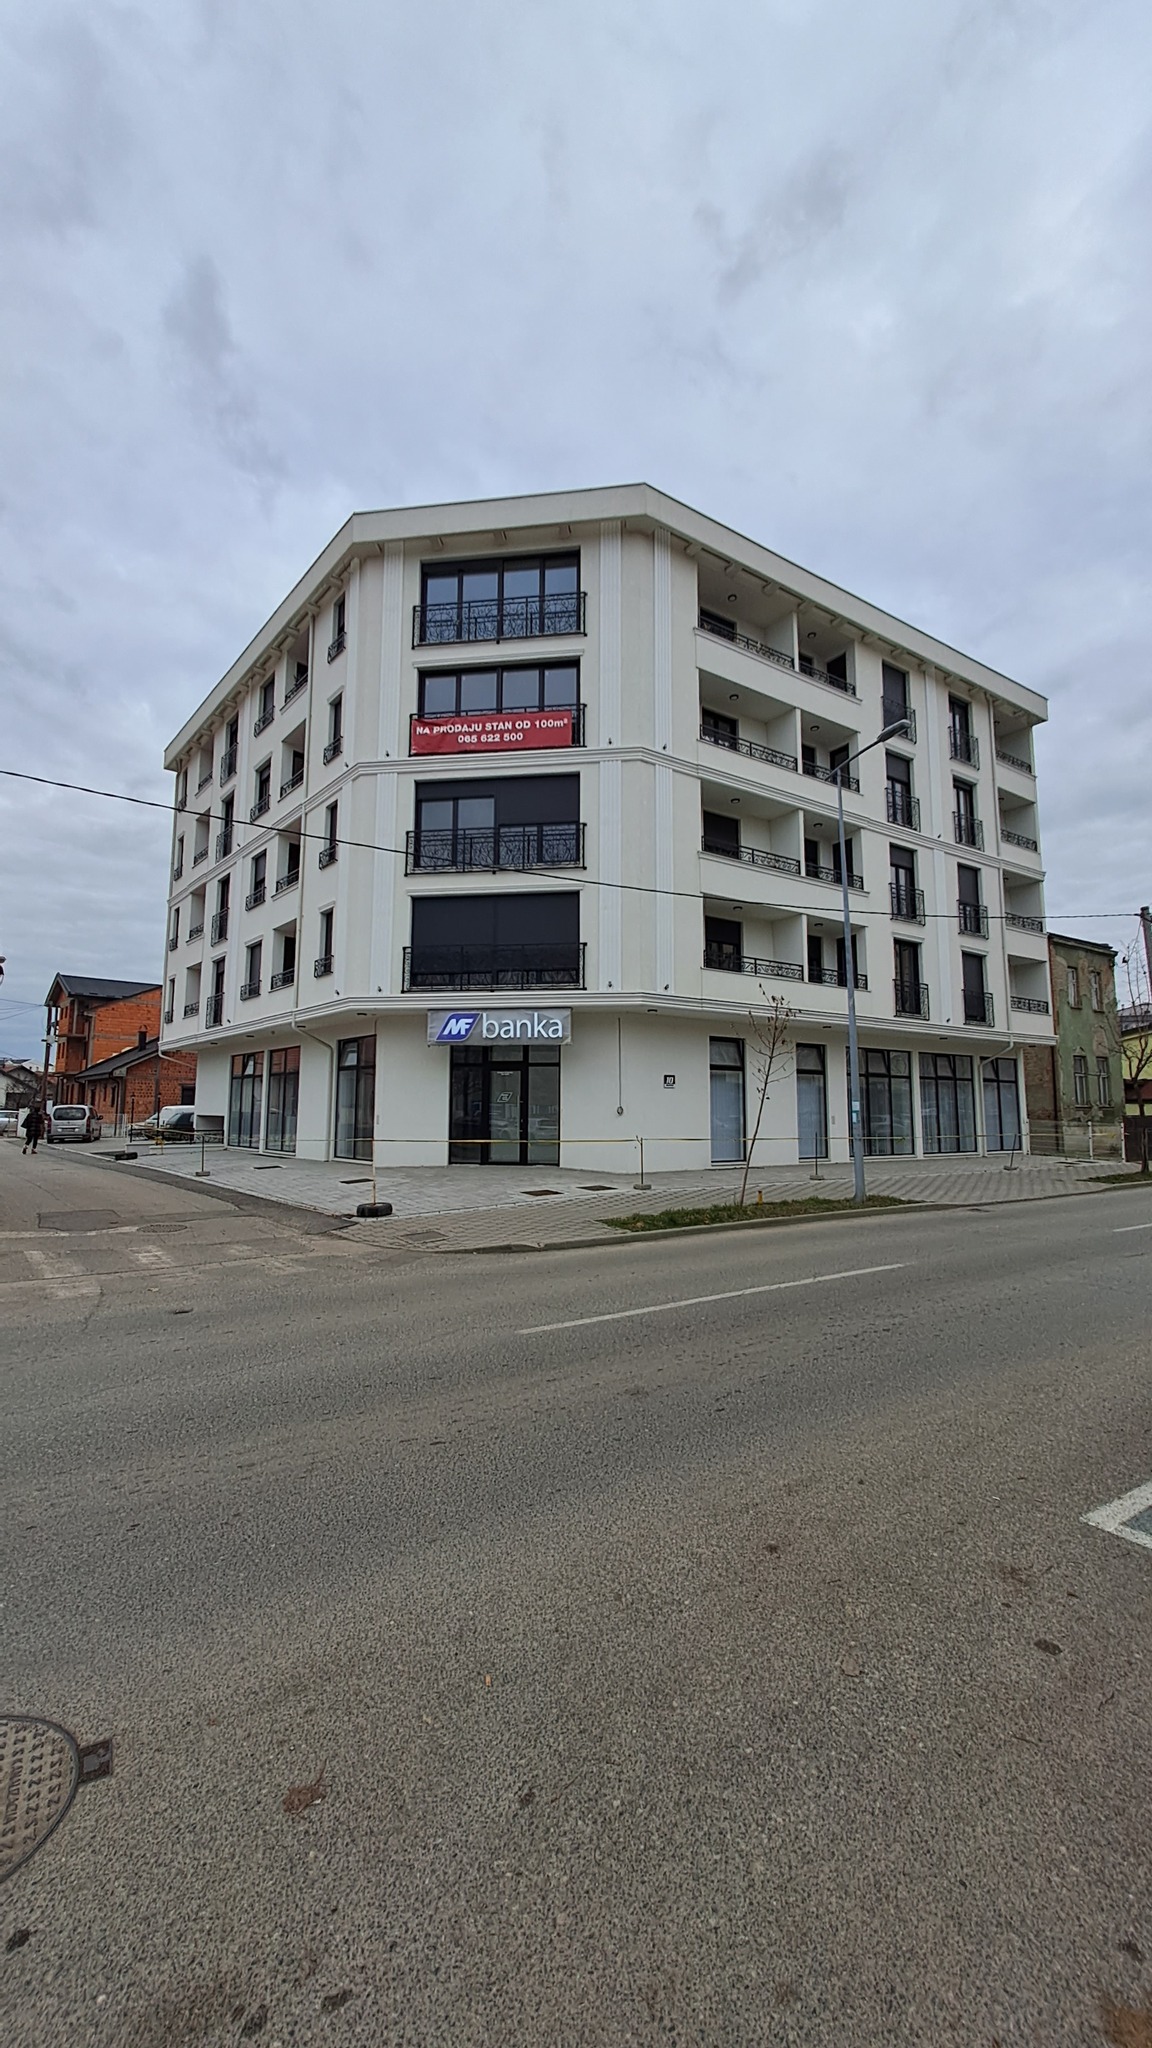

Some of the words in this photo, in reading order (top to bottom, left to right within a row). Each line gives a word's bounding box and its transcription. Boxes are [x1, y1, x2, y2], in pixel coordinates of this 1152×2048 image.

[416, 726, 430, 735] NA
[433, 723, 482, 734] PRODAJU
[485, 720, 512, 731] STAN
[515, 720, 531, 729] OD
[457, 734, 478, 743] 065
[480, 733, 501, 742] 622
[503, 732, 524, 741] 500
[442, 1018, 474, 1035] MF
[482, 1012, 563, 1039] banka
